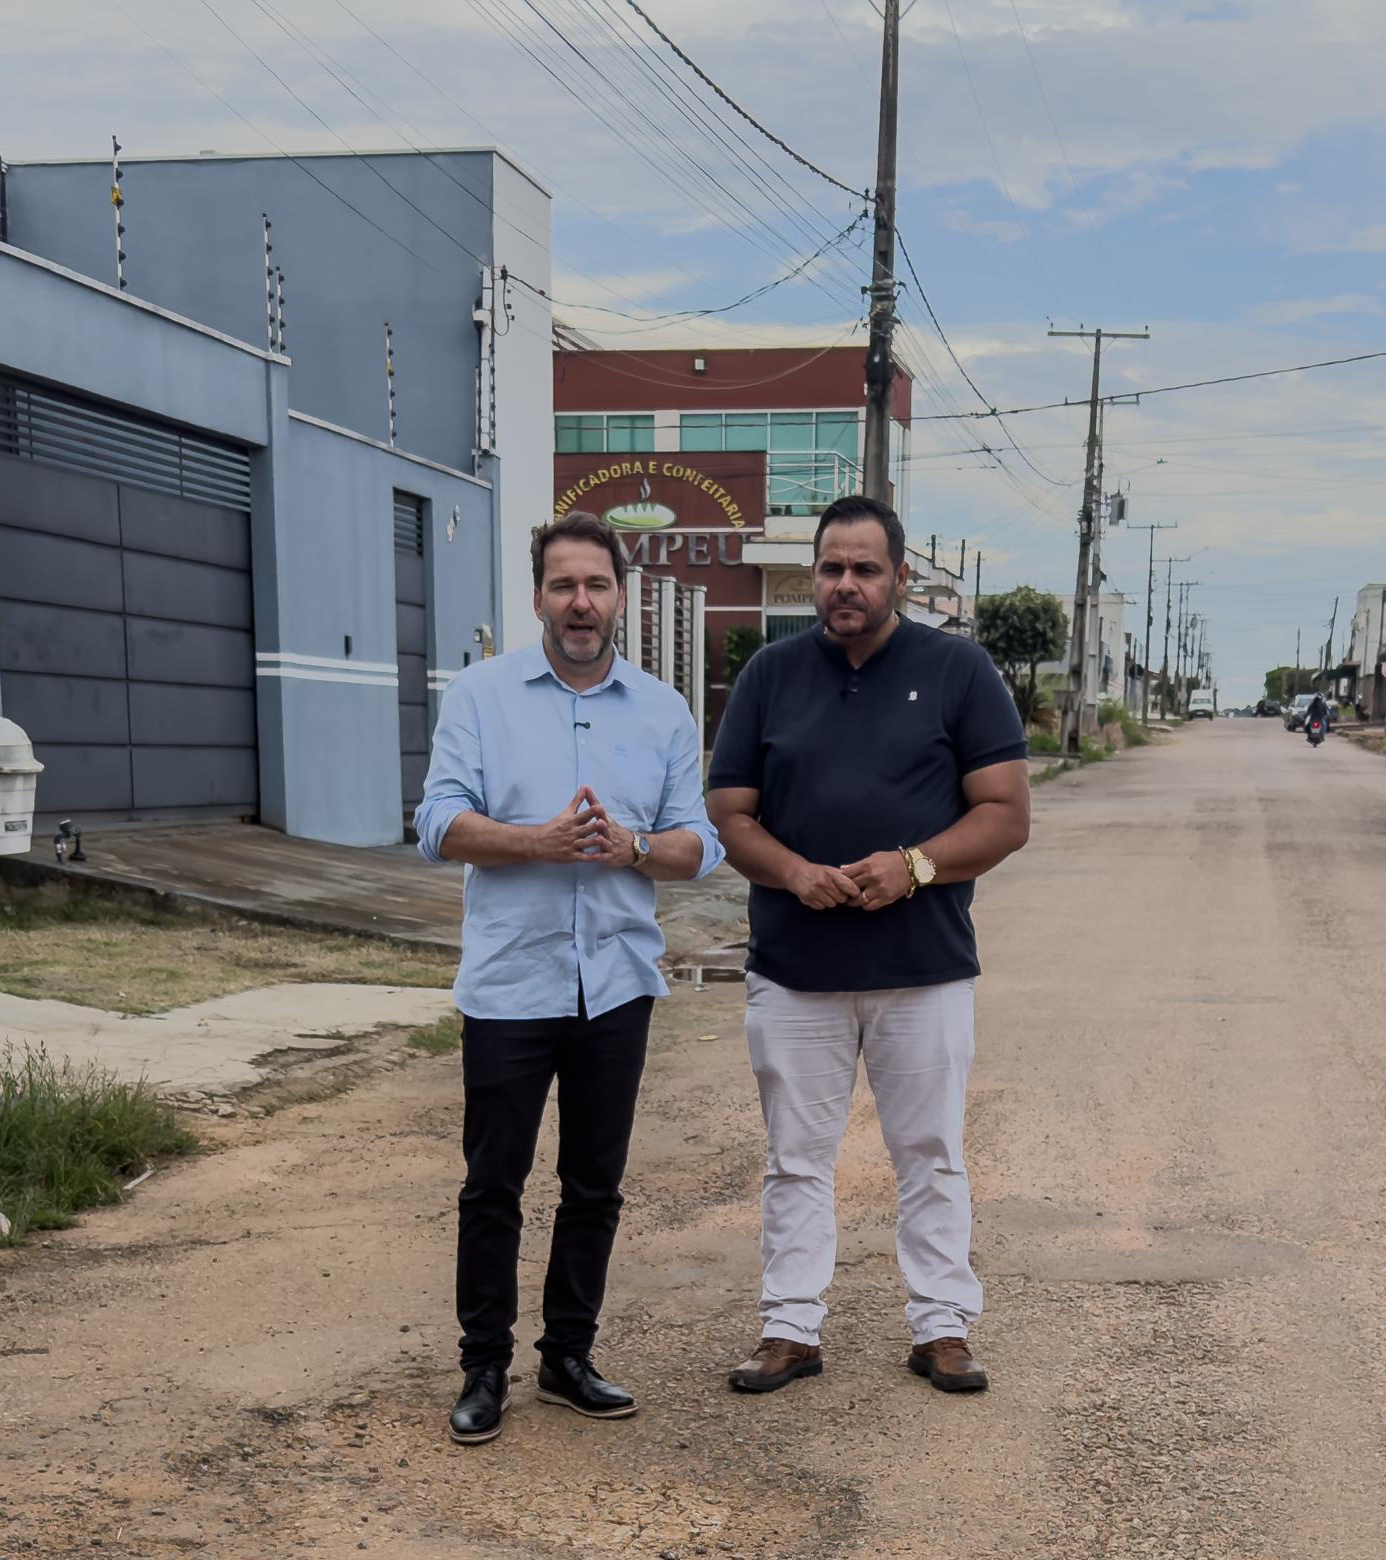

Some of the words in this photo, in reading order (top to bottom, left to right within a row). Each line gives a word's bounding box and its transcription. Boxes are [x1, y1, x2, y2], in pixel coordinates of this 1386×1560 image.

[554, 461, 644, 521] ANIFICADORA
[648, 461, 658, 474] E
[663, 462, 747, 530] CONFEITARIA
